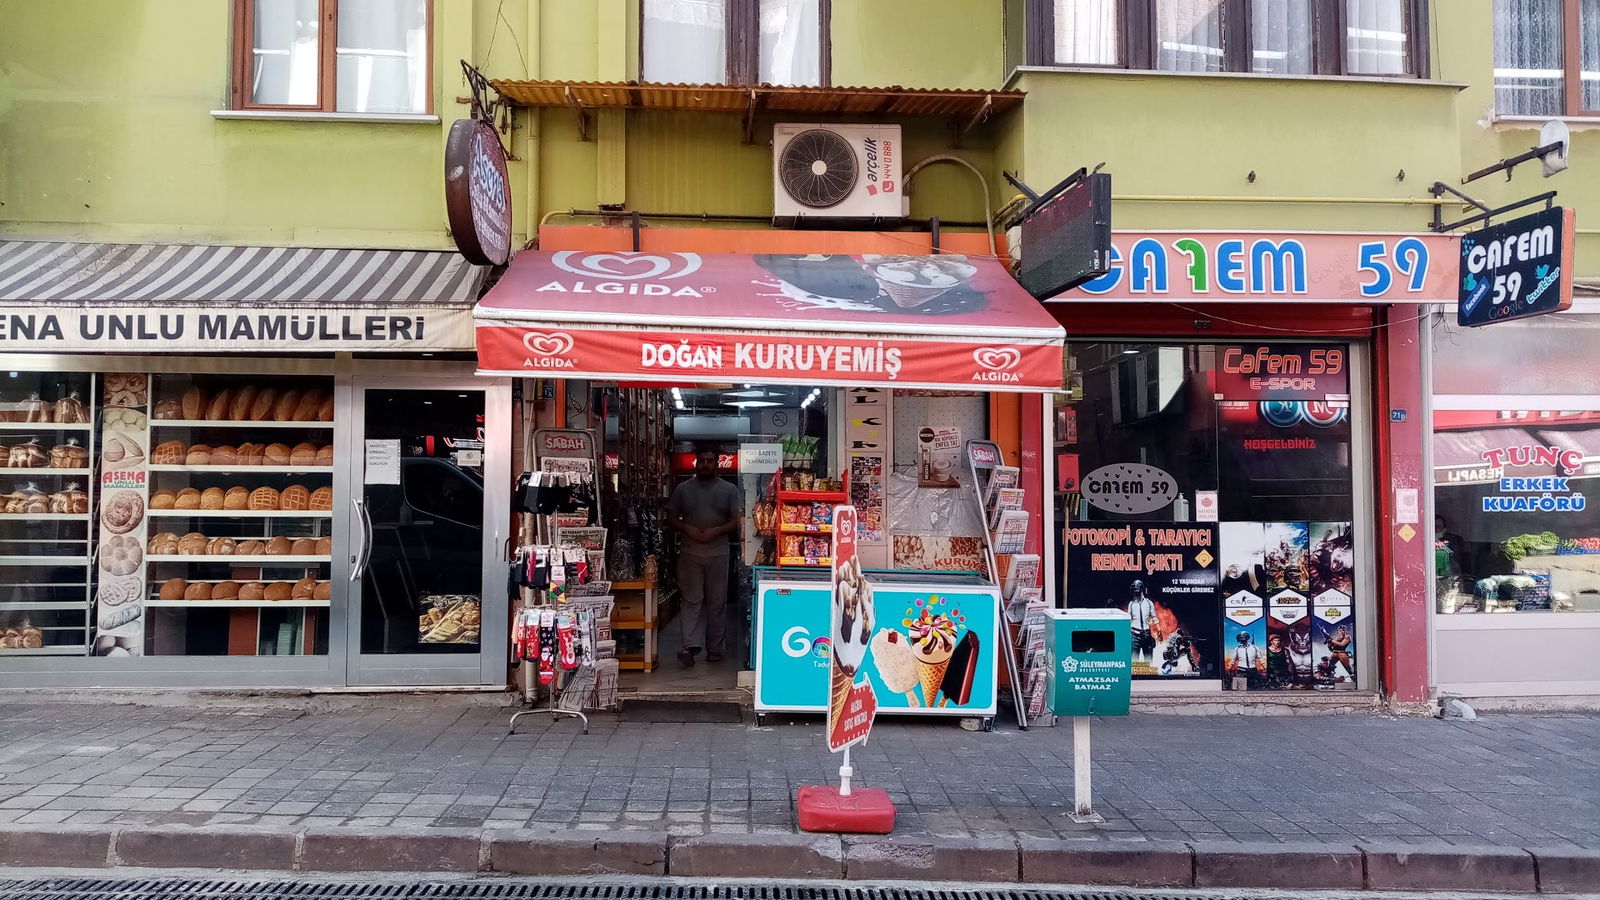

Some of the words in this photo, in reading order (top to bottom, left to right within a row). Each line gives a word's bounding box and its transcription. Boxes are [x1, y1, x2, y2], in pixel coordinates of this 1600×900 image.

[864, 137, 880, 182] arçelik
[1467, 225, 1553, 274] CAFEM
[1357, 236, 1430, 296] 59
[1465, 284, 1487, 311] facebook
[1492, 272, 1522, 305] 59
[1526, 268, 1560, 304] twitter
[80, 314, 184, 341] UNLU
[641, 338, 723, 369] DOĞAN
[734, 341, 902, 380] KURUYEMİŞ
[1223, 347, 1302, 374] Cafem
[1308, 349, 1343, 375] 59
[1250, 377, 1316, 390] E-SPOR
[546, 437, 584, 449] SABAH
[1482, 446, 1584, 476] TUNÇ
[103, 472, 145, 484] ASENA
[1088, 481, 1143, 494] CAFEM
[1151, 481, 1169, 494] 59
[1500, 477, 1569, 492] ERKEK
[1483, 493, 1585, 512] KUAFÖRÜ
[1134, 529, 1145, 546] &
[1149, 528, 1212, 546] TARAYICI
[934, 558, 988, 574] KURUYE
[1091, 550, 1142, 571] RENKLİ
[1146, 554, 1183, 576] ÇIKTI
[1162, 586, 1190, 594] KÜÇÜKLER
